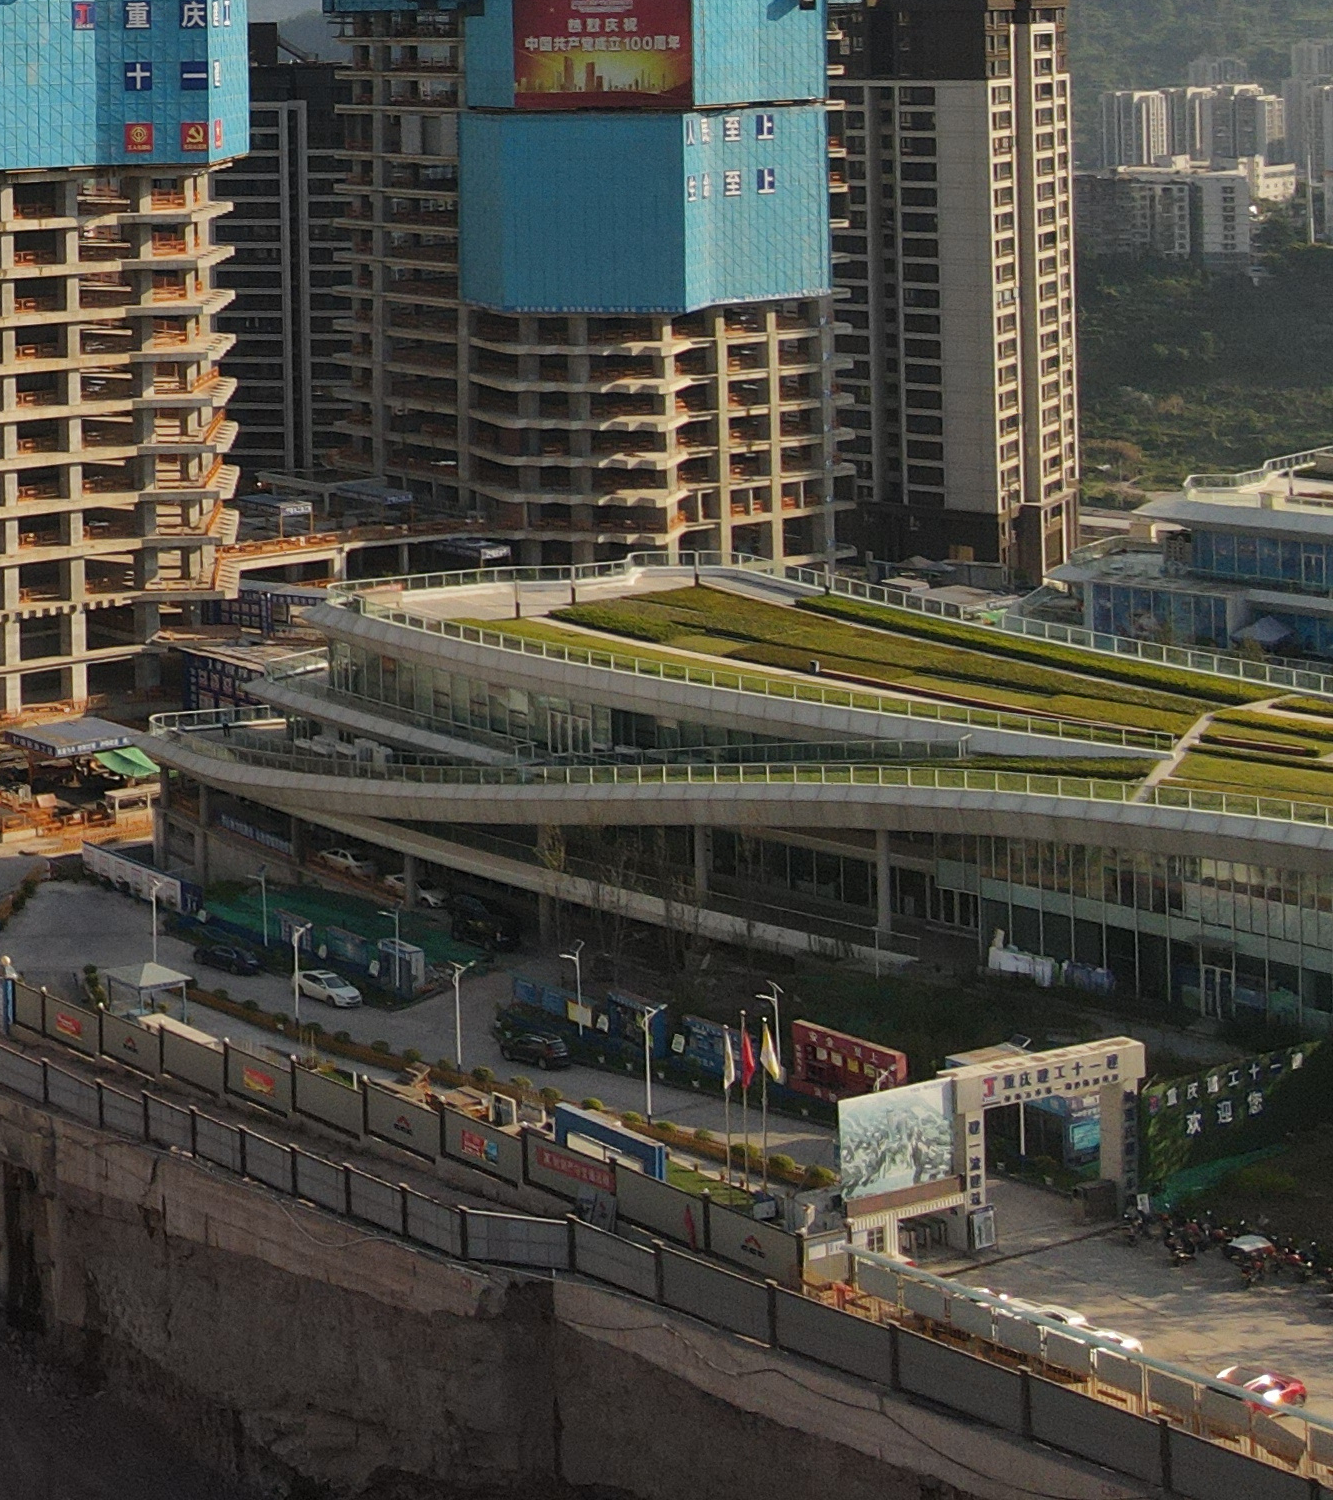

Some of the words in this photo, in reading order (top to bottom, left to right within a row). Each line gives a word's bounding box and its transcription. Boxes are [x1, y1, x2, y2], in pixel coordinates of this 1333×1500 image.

[567, 17, 639, 33] 热烈庆祝
[525, 35, 681, 52] 中国共产党成立100周年
[686, 114, 774, 146] 人民至上
[687, 168, 775, 202] 生命至上
